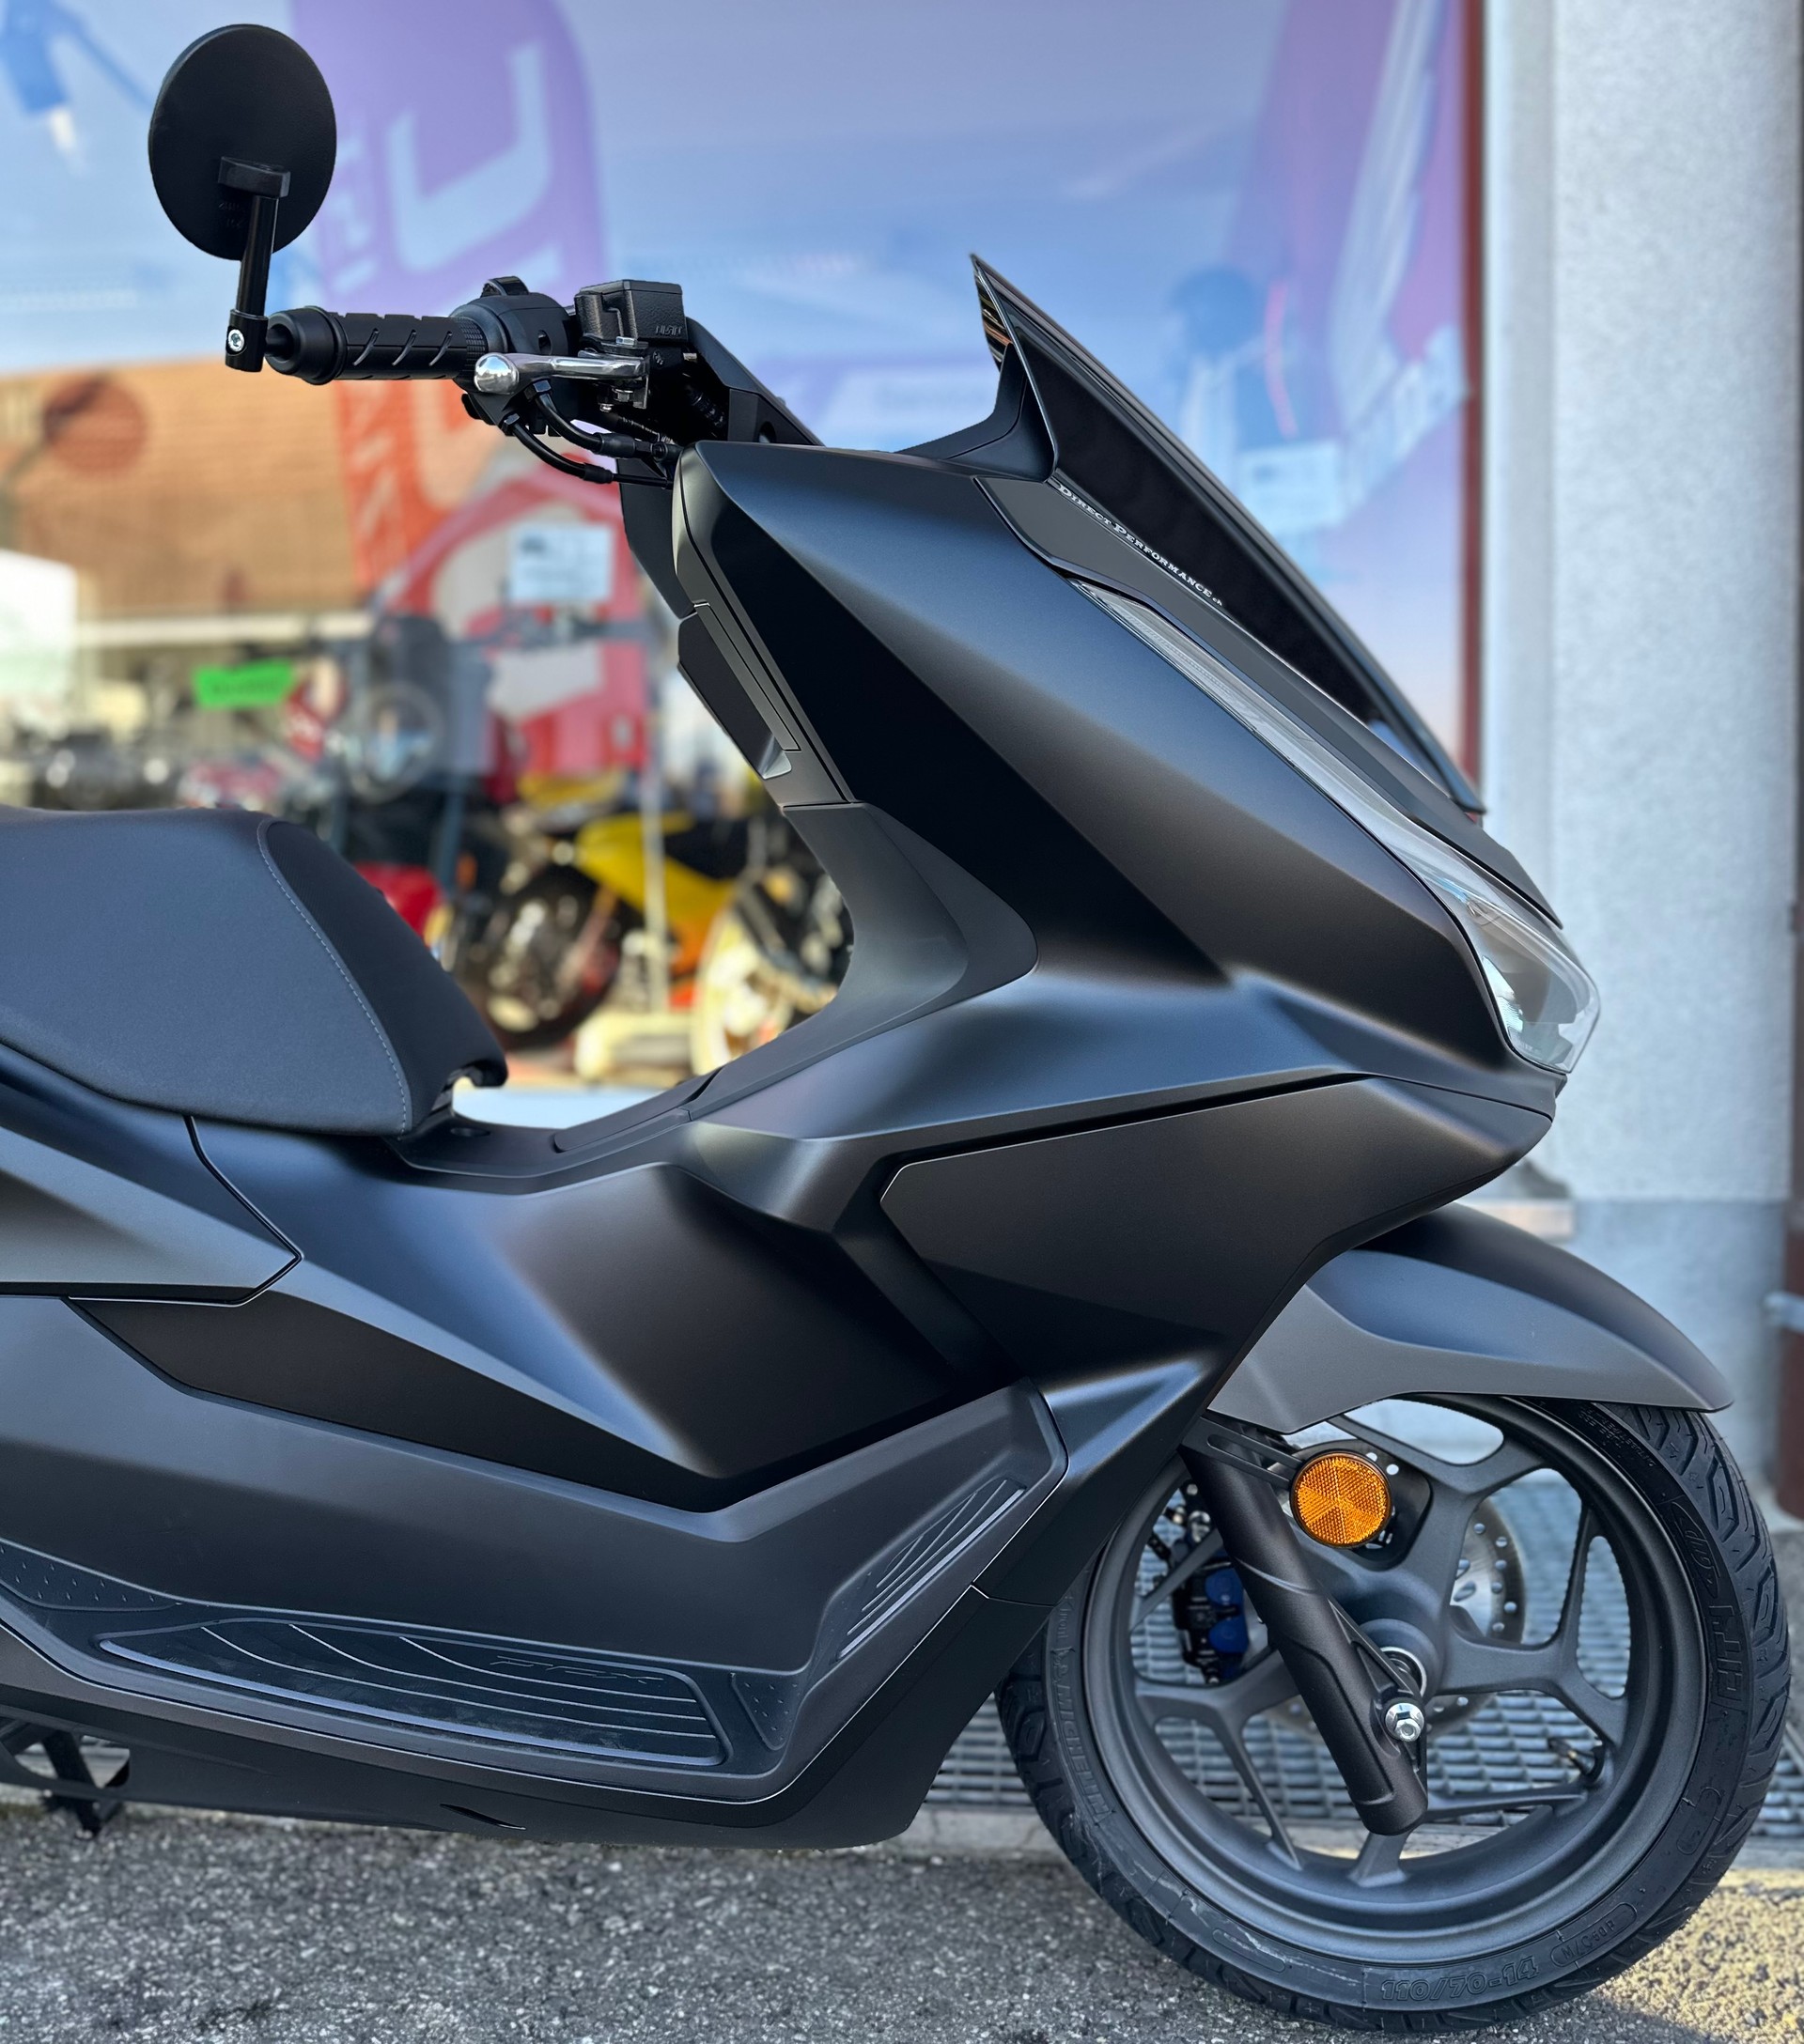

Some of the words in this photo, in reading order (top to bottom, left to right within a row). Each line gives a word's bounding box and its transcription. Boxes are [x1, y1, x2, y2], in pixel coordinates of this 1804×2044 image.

[1058, 483, 1112, 525] DIRECT
[1113, 523, 1213, 598] PERFORMANCE
[1056, 1684, 1111, 1815] MICHELIN
[1380, 1955, 1539, 2002] 110/70-14
